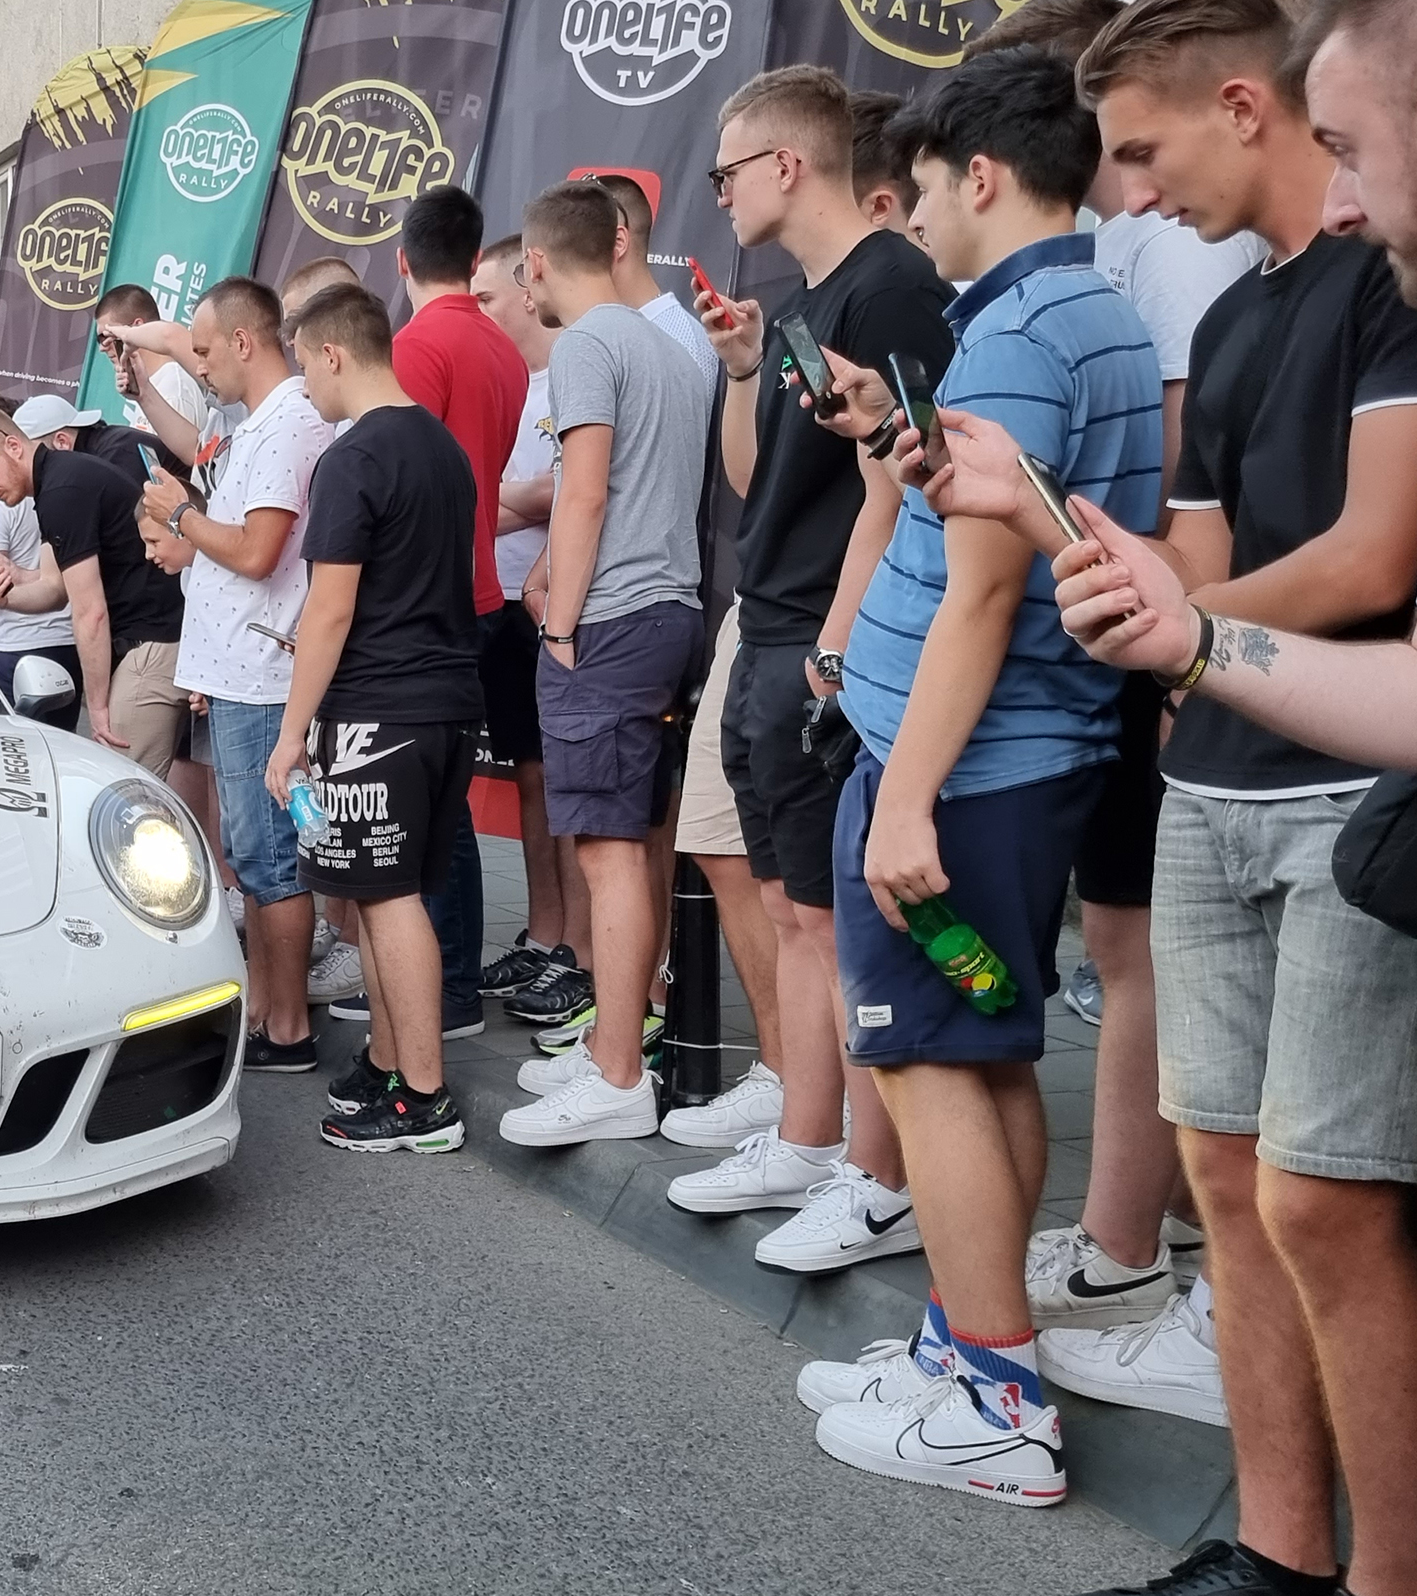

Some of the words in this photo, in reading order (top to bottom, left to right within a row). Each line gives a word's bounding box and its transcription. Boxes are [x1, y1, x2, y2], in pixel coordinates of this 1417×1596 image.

[616, 70, 655, 88] TV
[334, 93, 426, 135] ONELIFERALLY.COM
[179, 173, 228, 189] RALLY
[306, 190, 392, 228] RALLY
[647, 253, 690, 267] ERALLY
[41, 279, 98, 295] RALLY
[370, 822, 400, 836] BEIJING
[362, 836, 392, 847] MEXICO
[392, 831, 408, 844] CITY
[324, 848, 357, 859] ANGELES
[372, 845, 400, 857] BERLIN
[316, 856, 330, 868] NEW
[330, 859, 351, 870] YORK
[373, 856, 399, 868] SEOUL
[995, 1482, 1020, 1495] AIR
